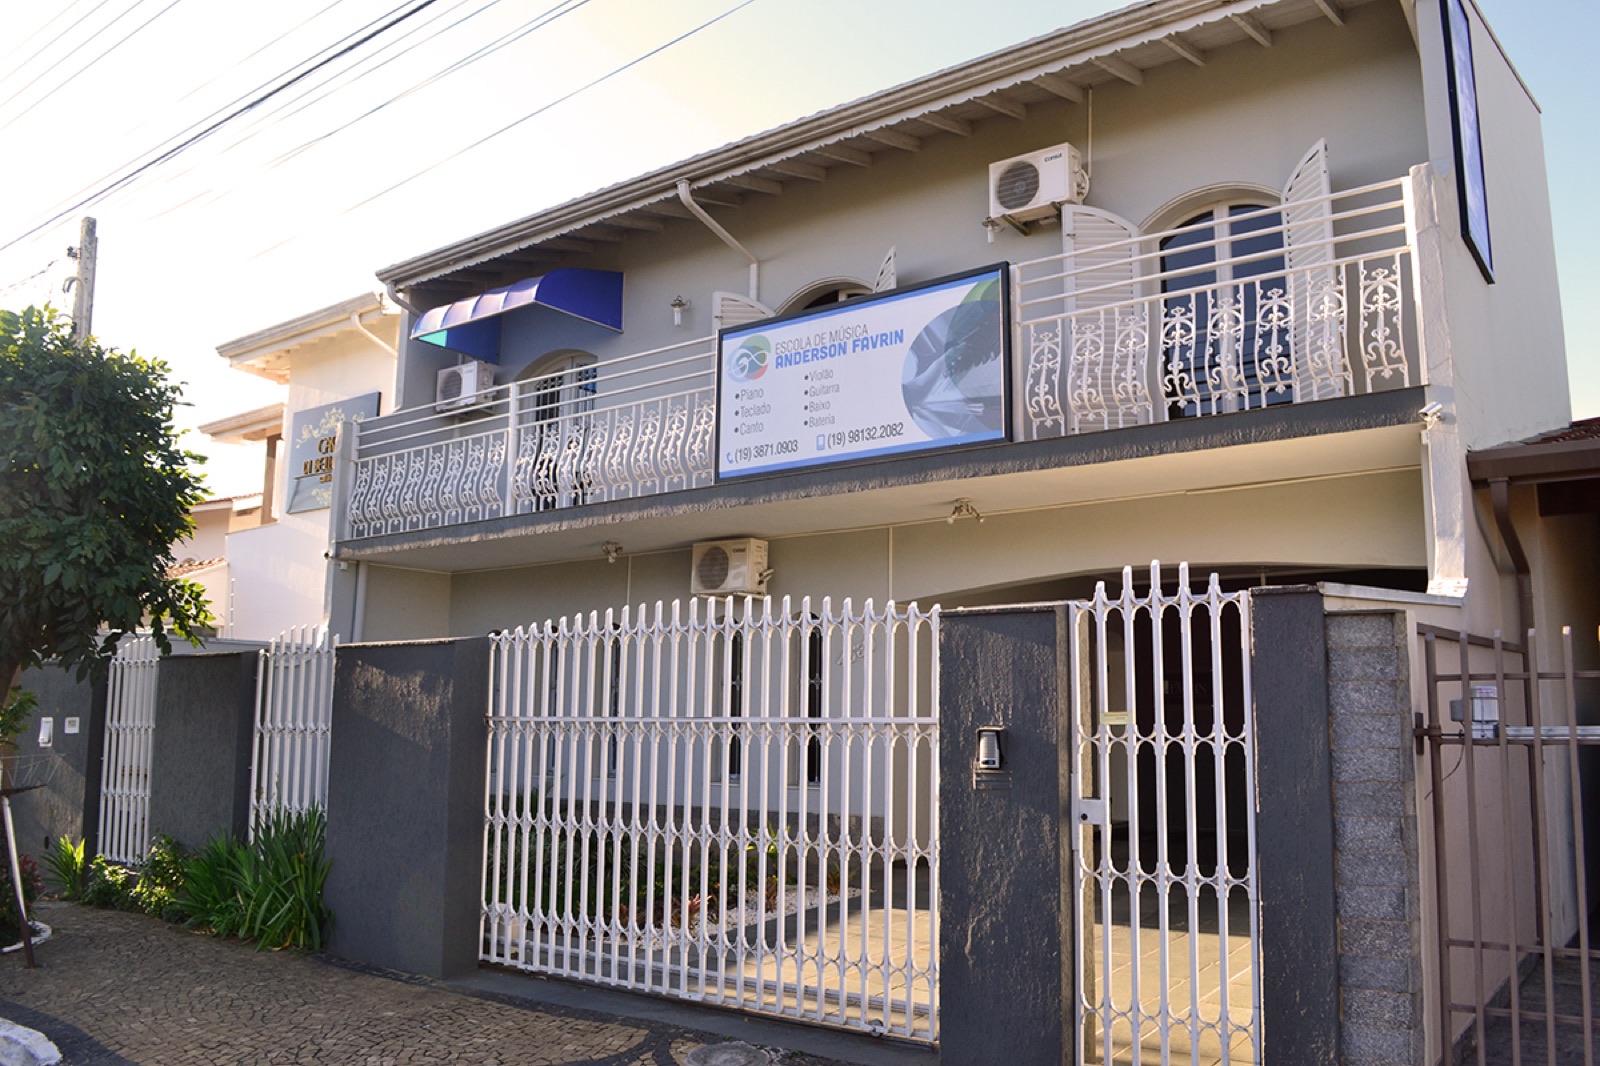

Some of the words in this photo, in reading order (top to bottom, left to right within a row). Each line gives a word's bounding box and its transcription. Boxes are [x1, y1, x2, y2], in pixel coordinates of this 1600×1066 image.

[775, 336, 812, 355] ESCOLA
[814, 332, 827, 347] DE
[829, 324, 869, 343] MÚSICA
[775, 341, 848, 369] ANDERSON
[852, 329, 904, 354] FAVRIN
[810, 368, 834, 383] Violão
[740, 387, 764, 401] Piano
[809, 382, 841, 398] Guitarra
[740, 402, 772, 418] Teclado
[809, 400, 831, 413] Baixo
[739, 420, 764, 436] Canto
[808, 413, 836, 428] Bateria
[827, 431, 846, 450] (19)
[847, 421, 904, 444] 98132.2082
[735, 445, 752, 464] (19)
[753, 439, 798, 458] 3871.0903
